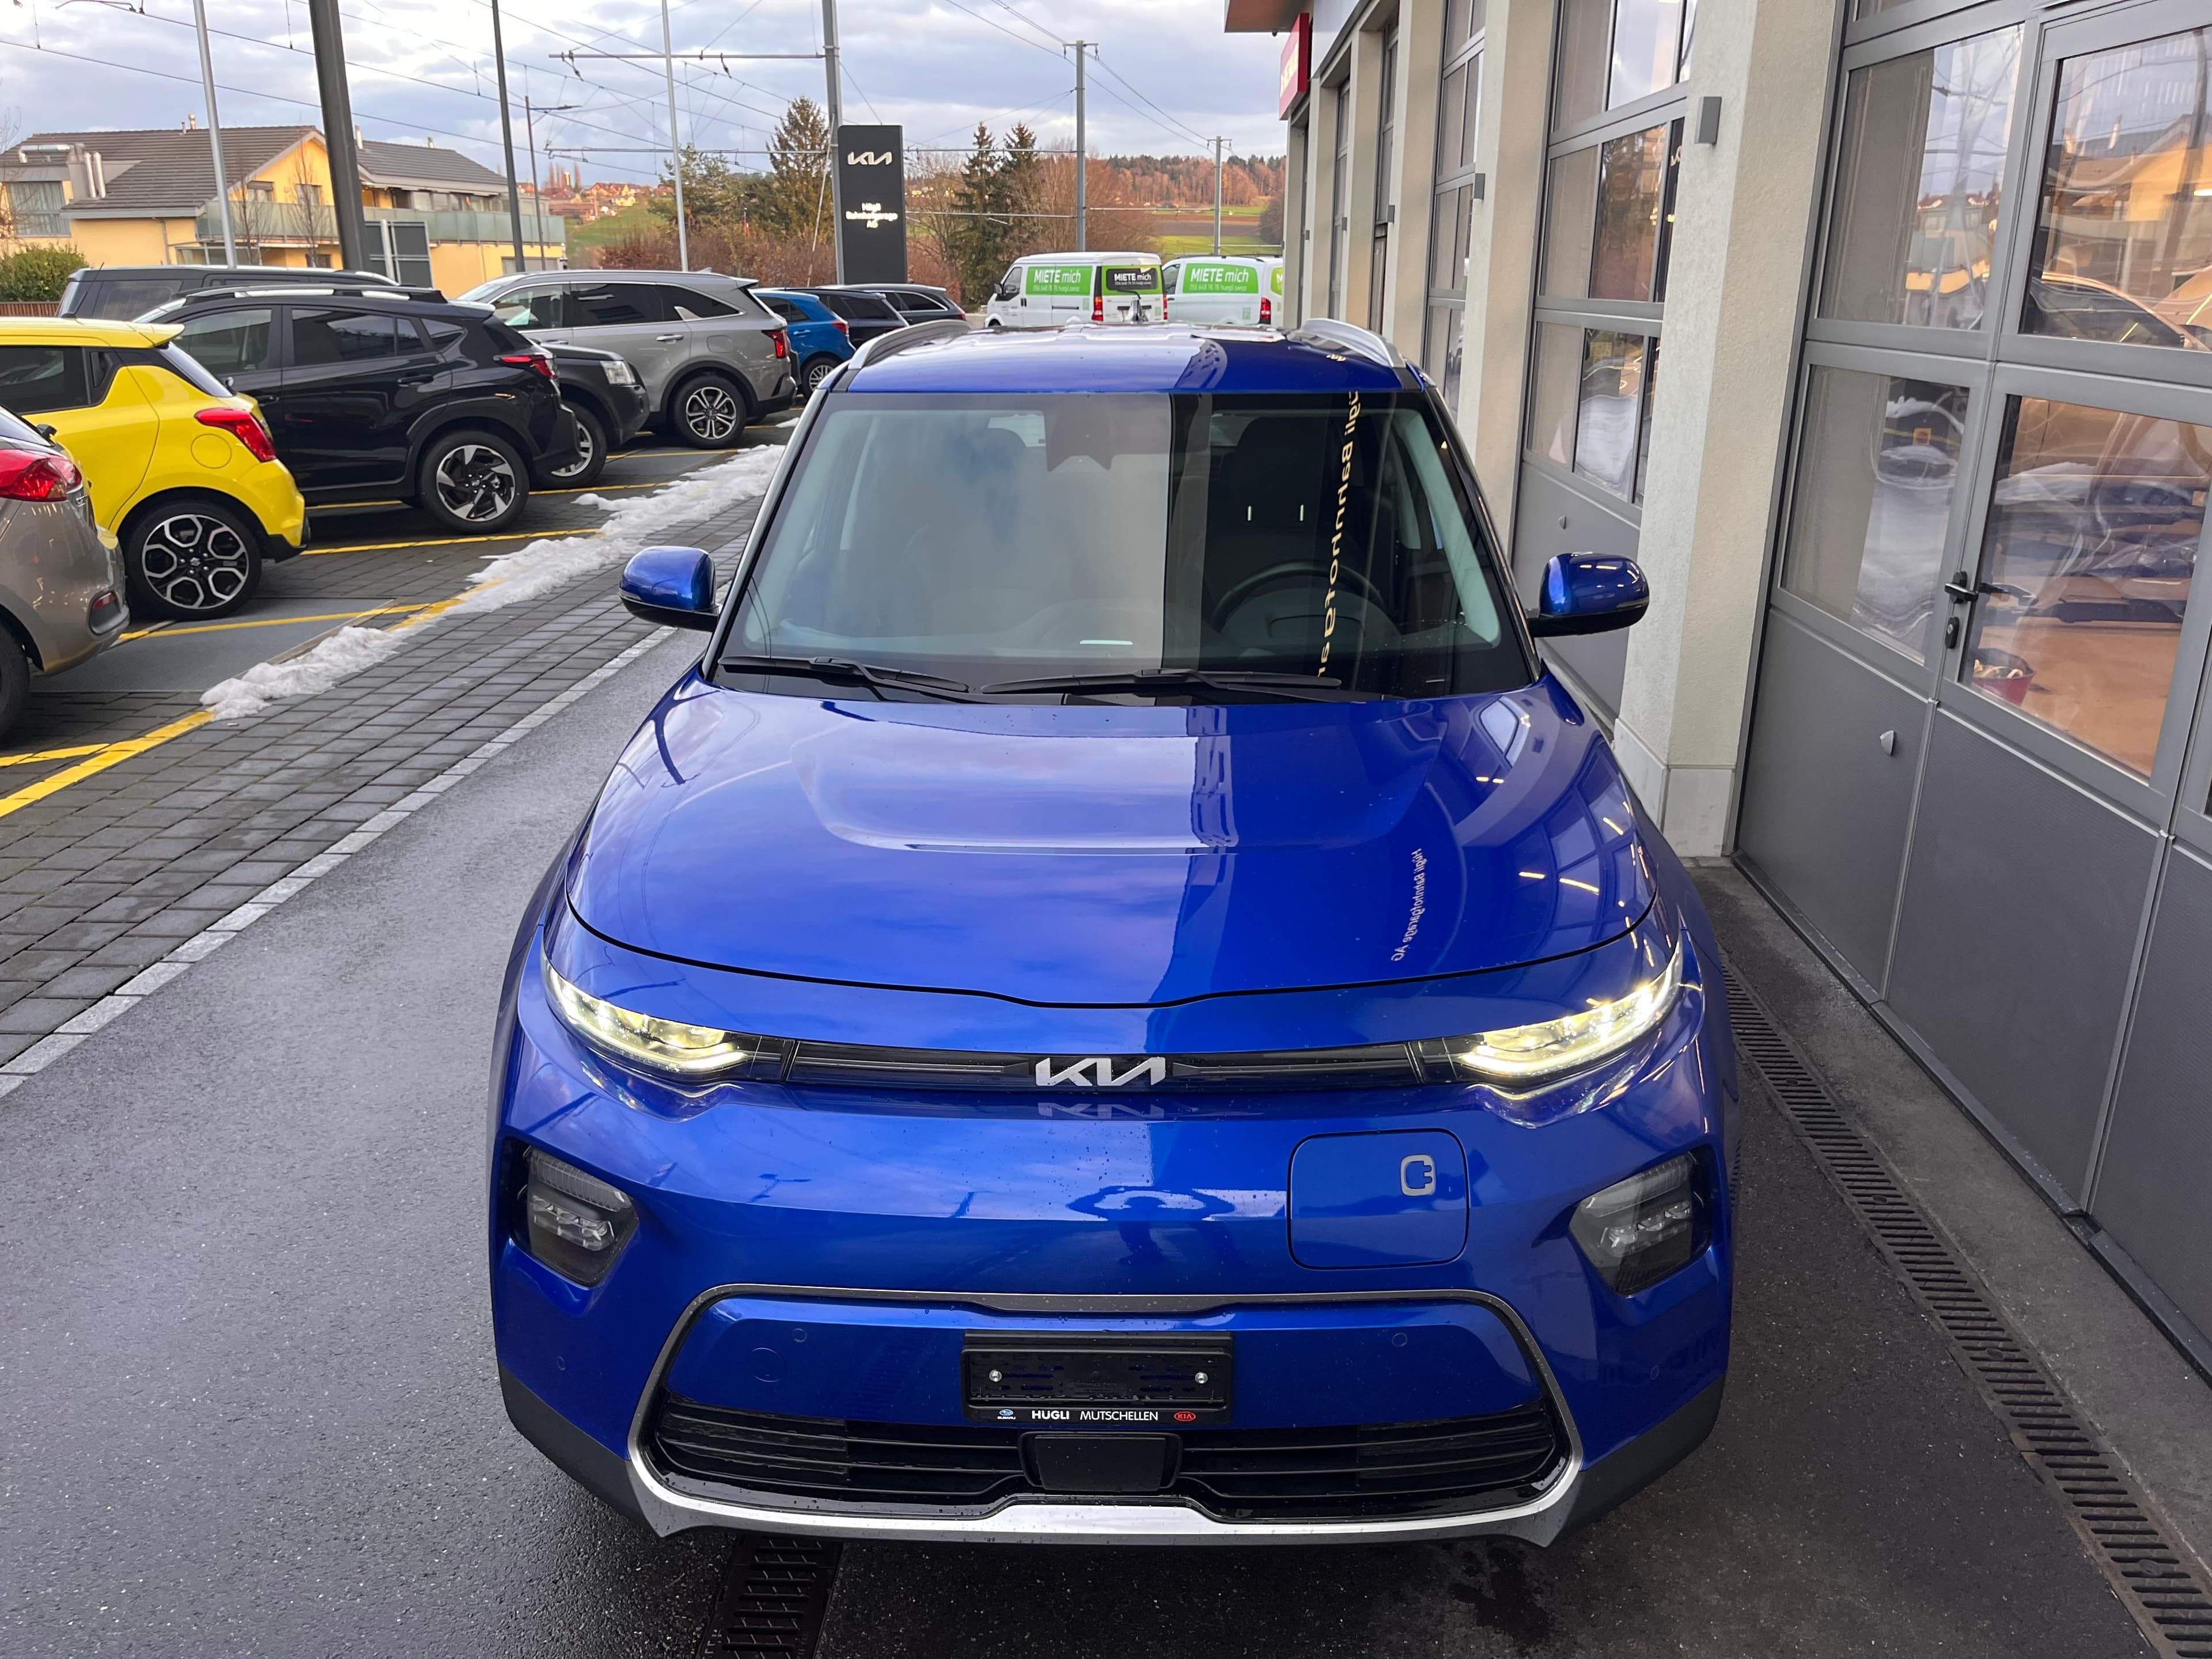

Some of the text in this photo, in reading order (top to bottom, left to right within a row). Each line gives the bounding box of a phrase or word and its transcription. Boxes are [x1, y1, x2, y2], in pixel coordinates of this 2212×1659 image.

[847, 151, 892, 165] KIA
[1034, 269, 1081, 284] MIETE mich
[1113, 272, 1152, 281] MIETE mich
[1190, 268, 1249, 283] MIETE mich
[1035, 1057, 1166, 1086] KIA
[1032, 1410, 1070, 1420] HÜGLI
[1080, 1411, 1158, 1421] MUTSCHELLEN
